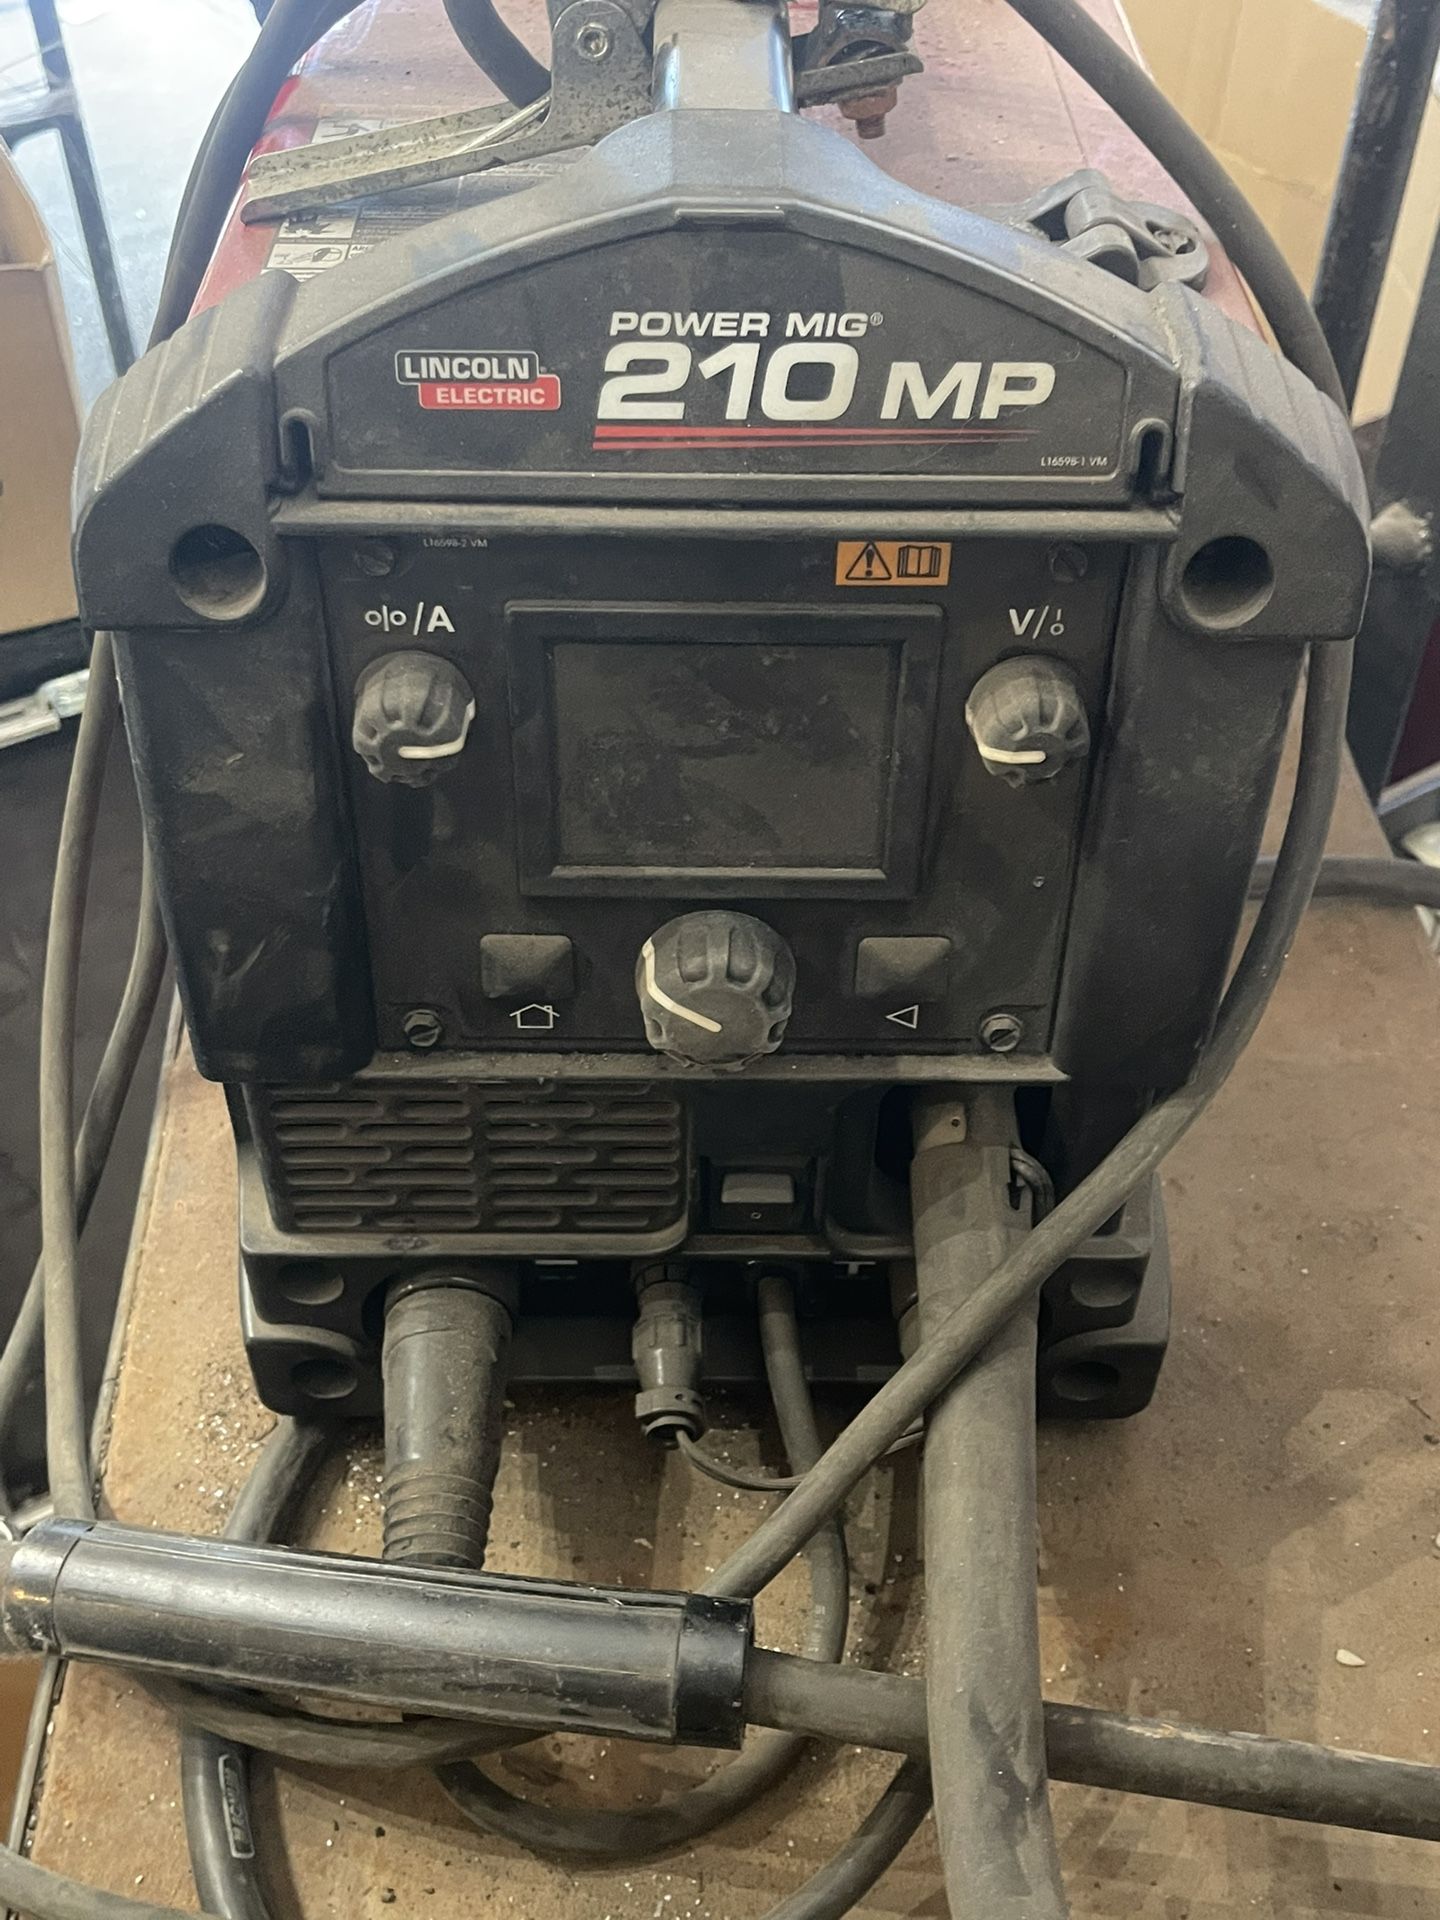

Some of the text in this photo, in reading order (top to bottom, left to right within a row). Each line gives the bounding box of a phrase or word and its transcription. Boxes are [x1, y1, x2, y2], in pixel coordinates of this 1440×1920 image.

[609, 311, 770, 337] POWER
[404, 356, 529, 380] LINCOLN
[597, 341, 1056, 421] 210 MP
[436, 387, 545, 405] ELECTRIC
